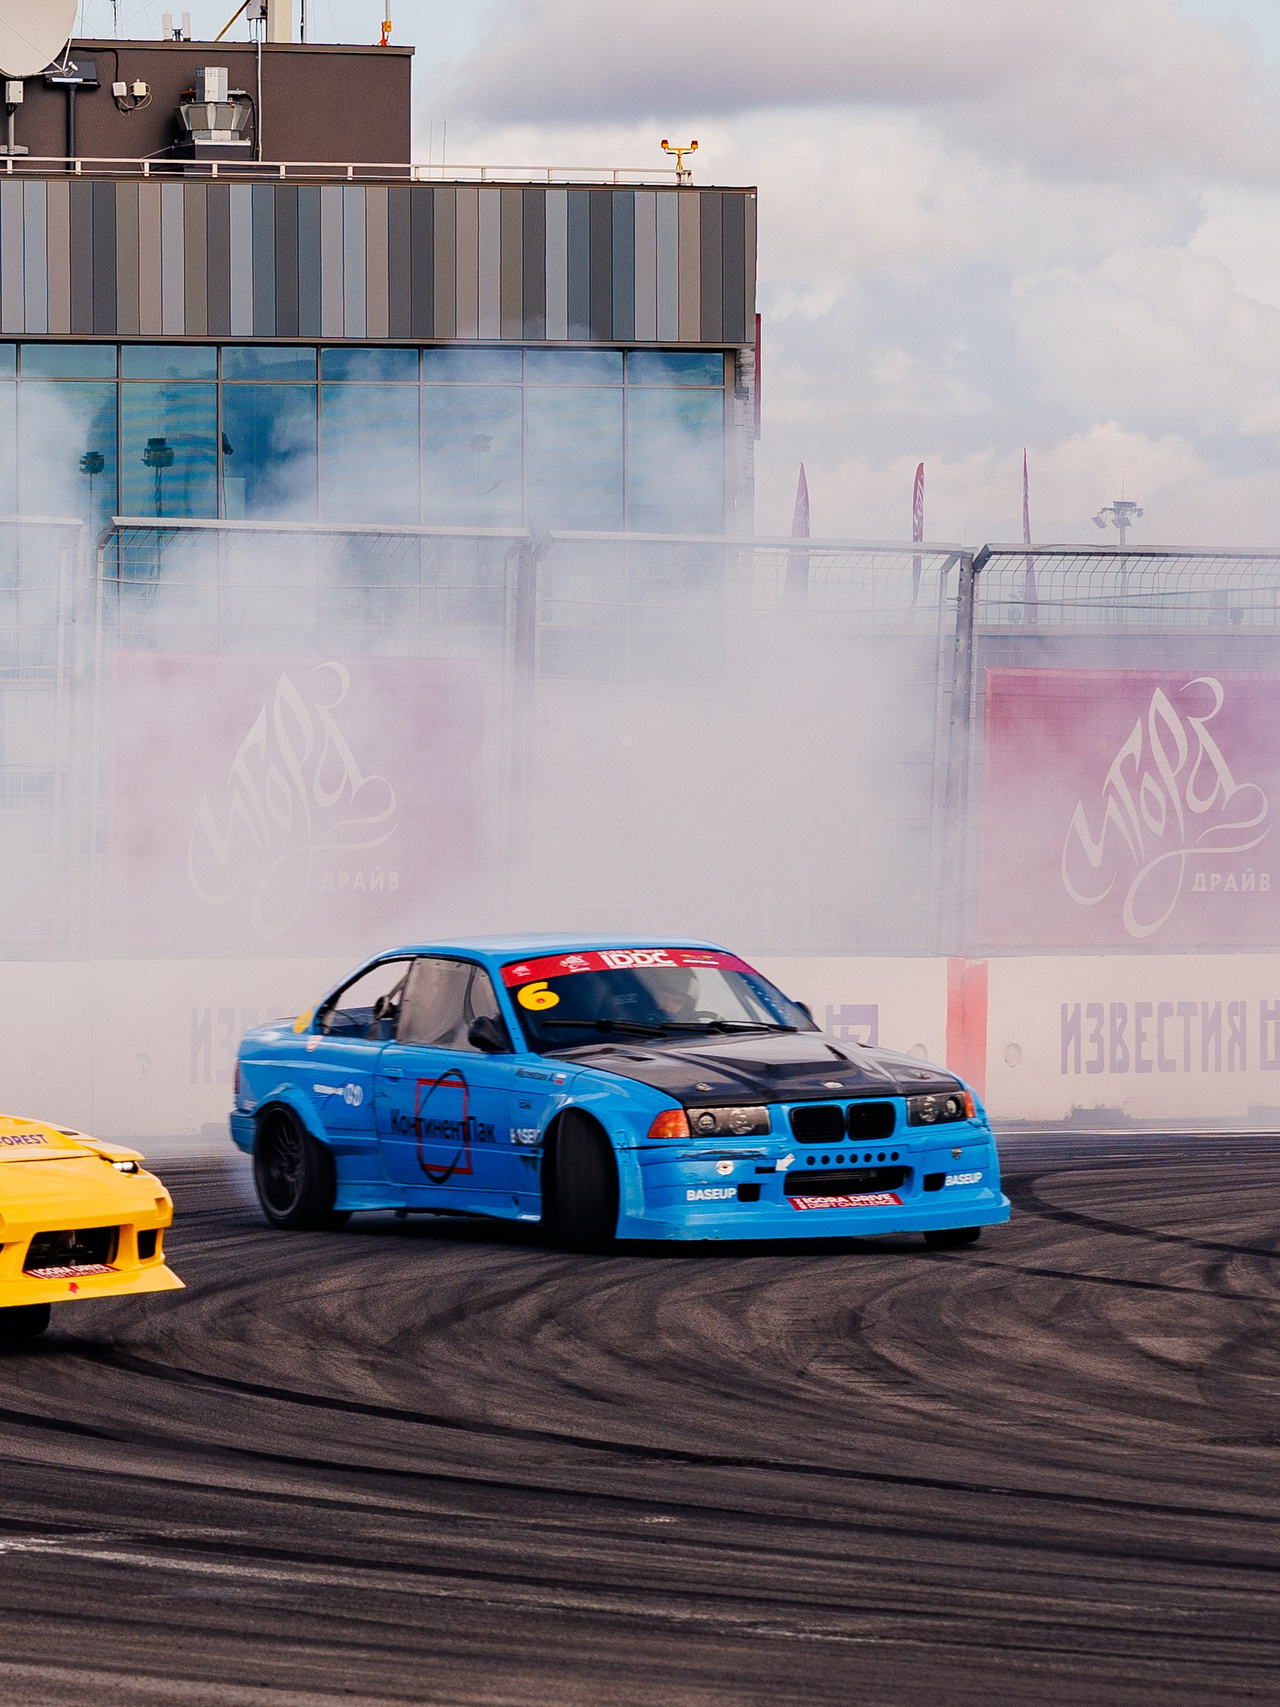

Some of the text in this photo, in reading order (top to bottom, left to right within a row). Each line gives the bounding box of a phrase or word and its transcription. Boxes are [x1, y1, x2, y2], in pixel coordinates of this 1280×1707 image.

[322, 866, 400, 891] ДРАЙВ
[1192, 868, 1270, 892] ДРАЙВ
[599, 953, 675, 967] IDDC
[517, 981, 560, 1010] 6
[1061, 1001, 1247, 1074] ИЗВЕСТИЯ
[944, 1172, 983, 1187] BASEUP
[686, 1187, 737, 1201] BASEUP
[849, 1193, 894, 1202] DRIVE
